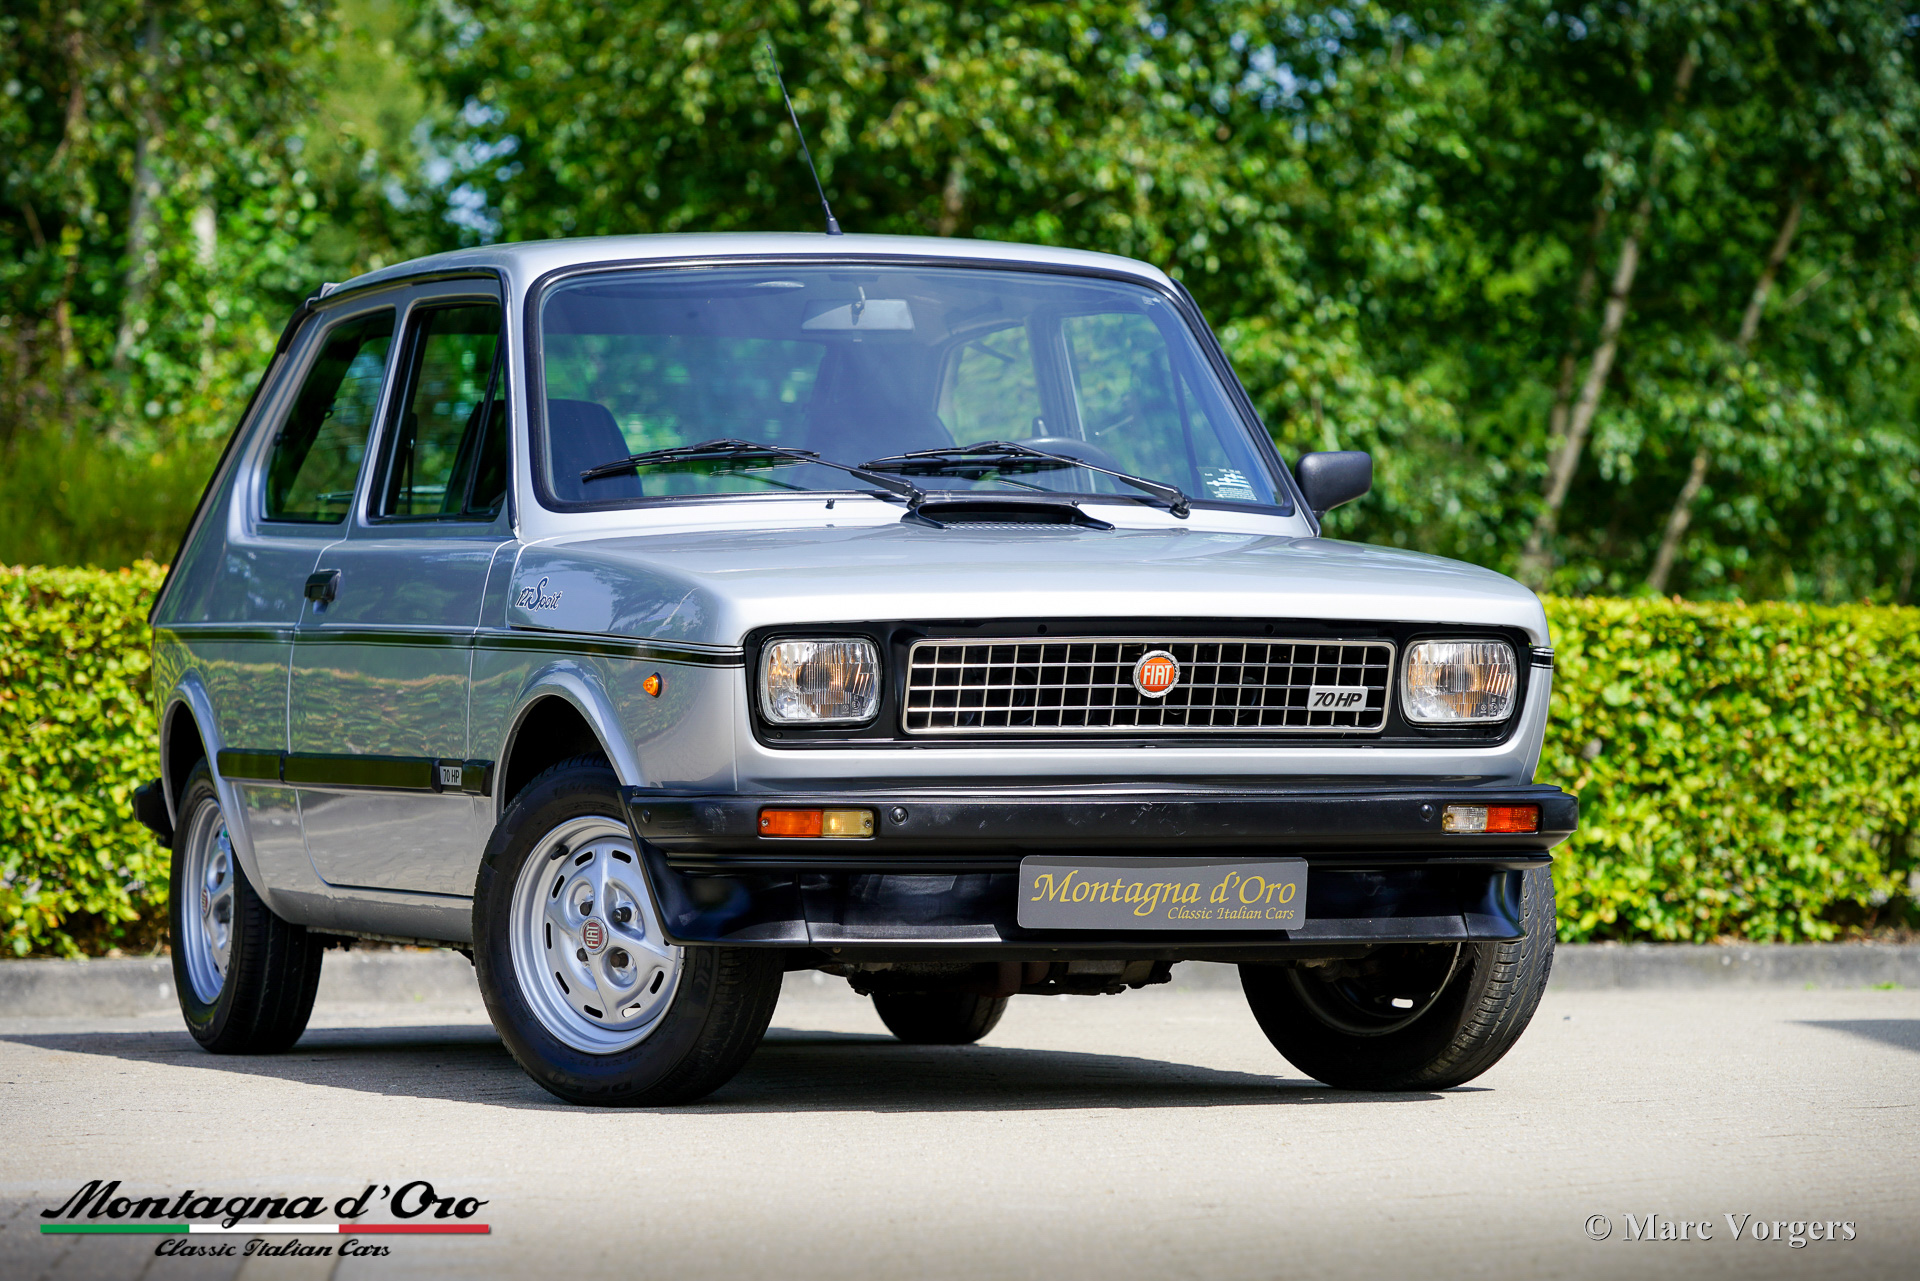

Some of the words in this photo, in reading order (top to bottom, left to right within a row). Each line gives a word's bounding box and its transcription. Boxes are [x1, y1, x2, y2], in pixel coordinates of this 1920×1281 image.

[1143, 665, 1172, 685] FIAT
[1313, 692, 1336, 707] 70
[1334, 692, 1363, 707] HP
[443, 769, 451, 783] 70
[451, 769, 460, 783] HP
[1030, 870, 1202, 917] Montagna
[1209, 871, 1297, 905] d'Oro
[1167, 907, 1213, 921] Classic
[1216, 905, 1263, 920] Italian
[1265, 907, 1295, 921] Cars
[586, 925, 599, 947] FIAT
